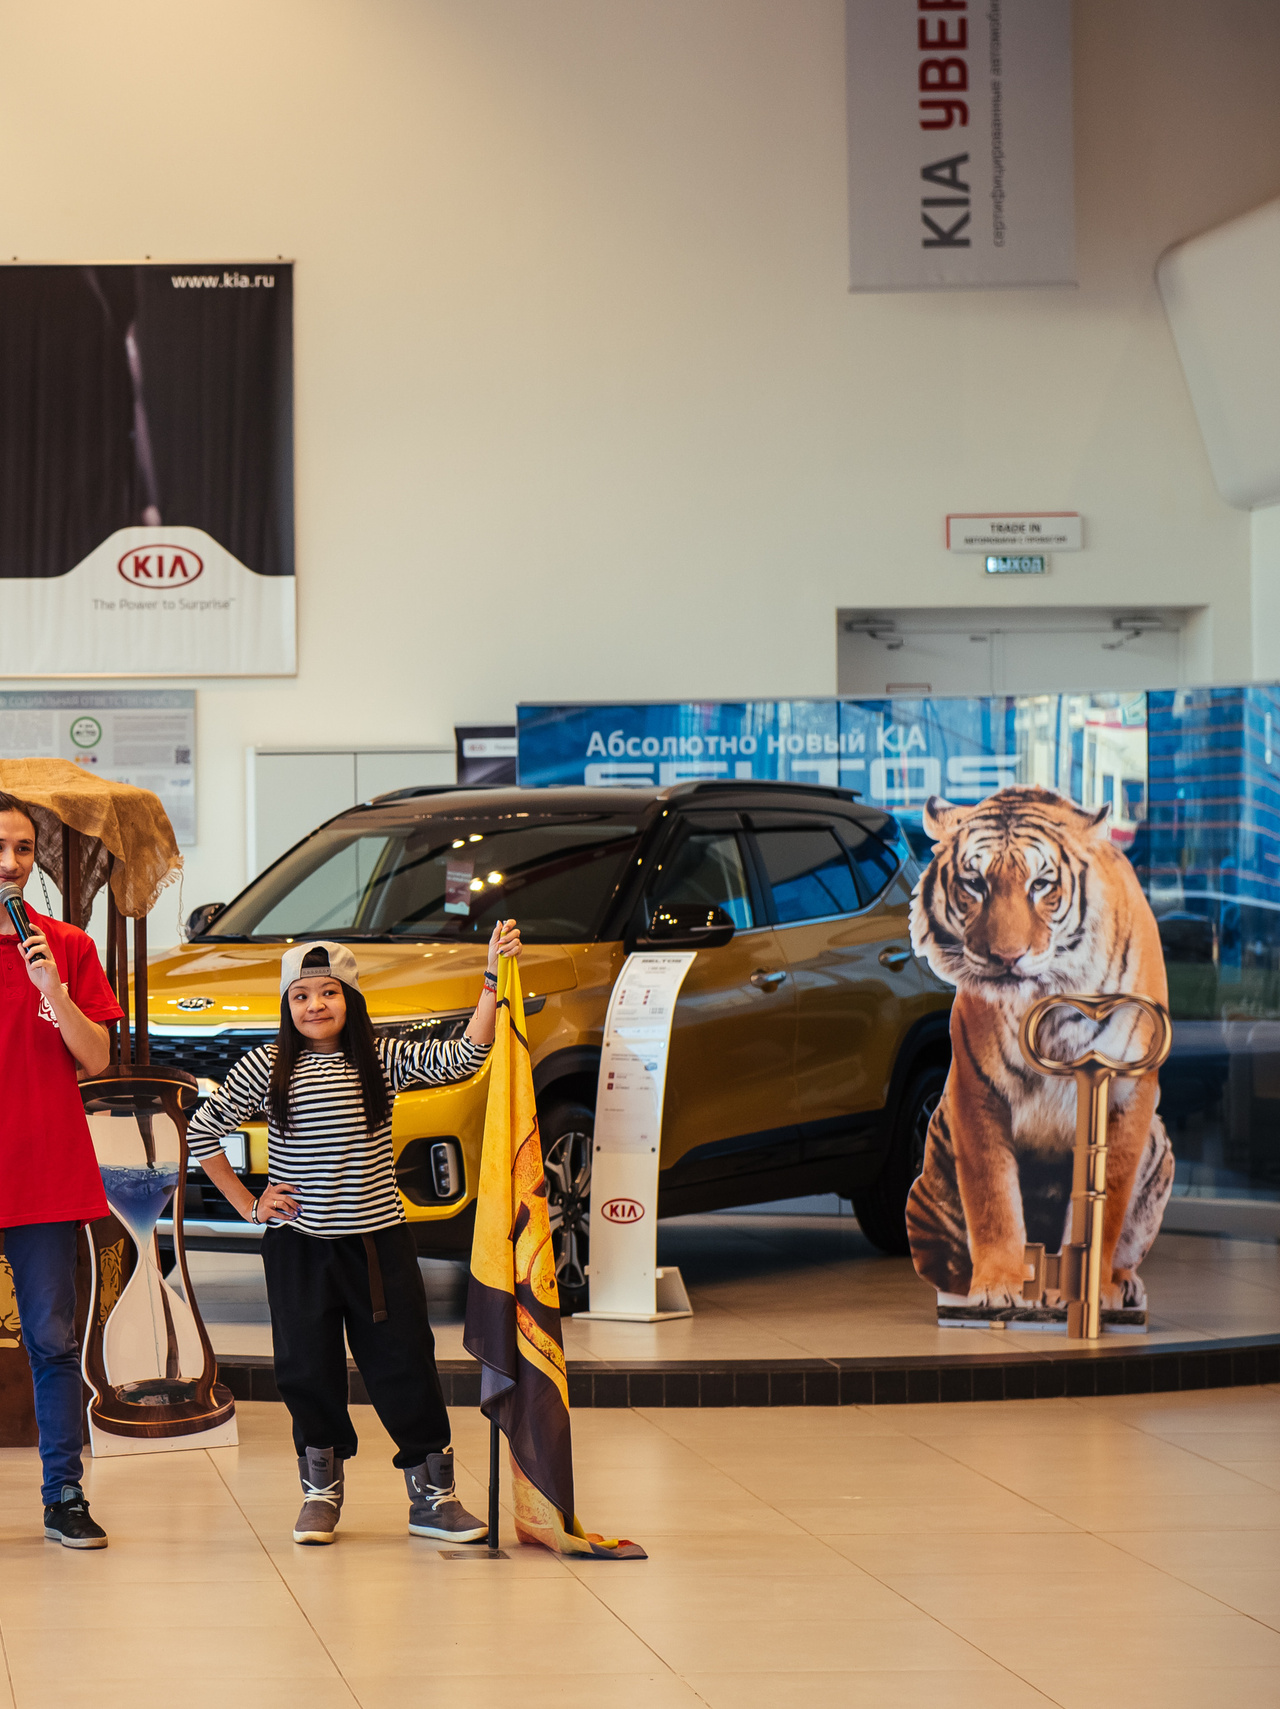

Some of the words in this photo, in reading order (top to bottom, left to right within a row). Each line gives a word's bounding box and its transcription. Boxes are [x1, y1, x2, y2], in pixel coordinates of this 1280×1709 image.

[918, 0, 968, 130] УВЕ
[922, 152, 970, 248] KIA
[171, 271, 275, 289] www.kia.ru
[990, 523, 1025, 534] TRADE
[1028, 523, 1042, 534] IN
[133, 554, 189, 578] KIA
[92, 598, 116, 611] The
[120, 598, 158, 611] Power
[162, 599, 175, 610] to
[585, 730, 758, 758] Абсолютно
[767, 727, 866, 755] новый
[876, 724, 927, 752] KIA
[609, 1204, 637, 1218] KIA
